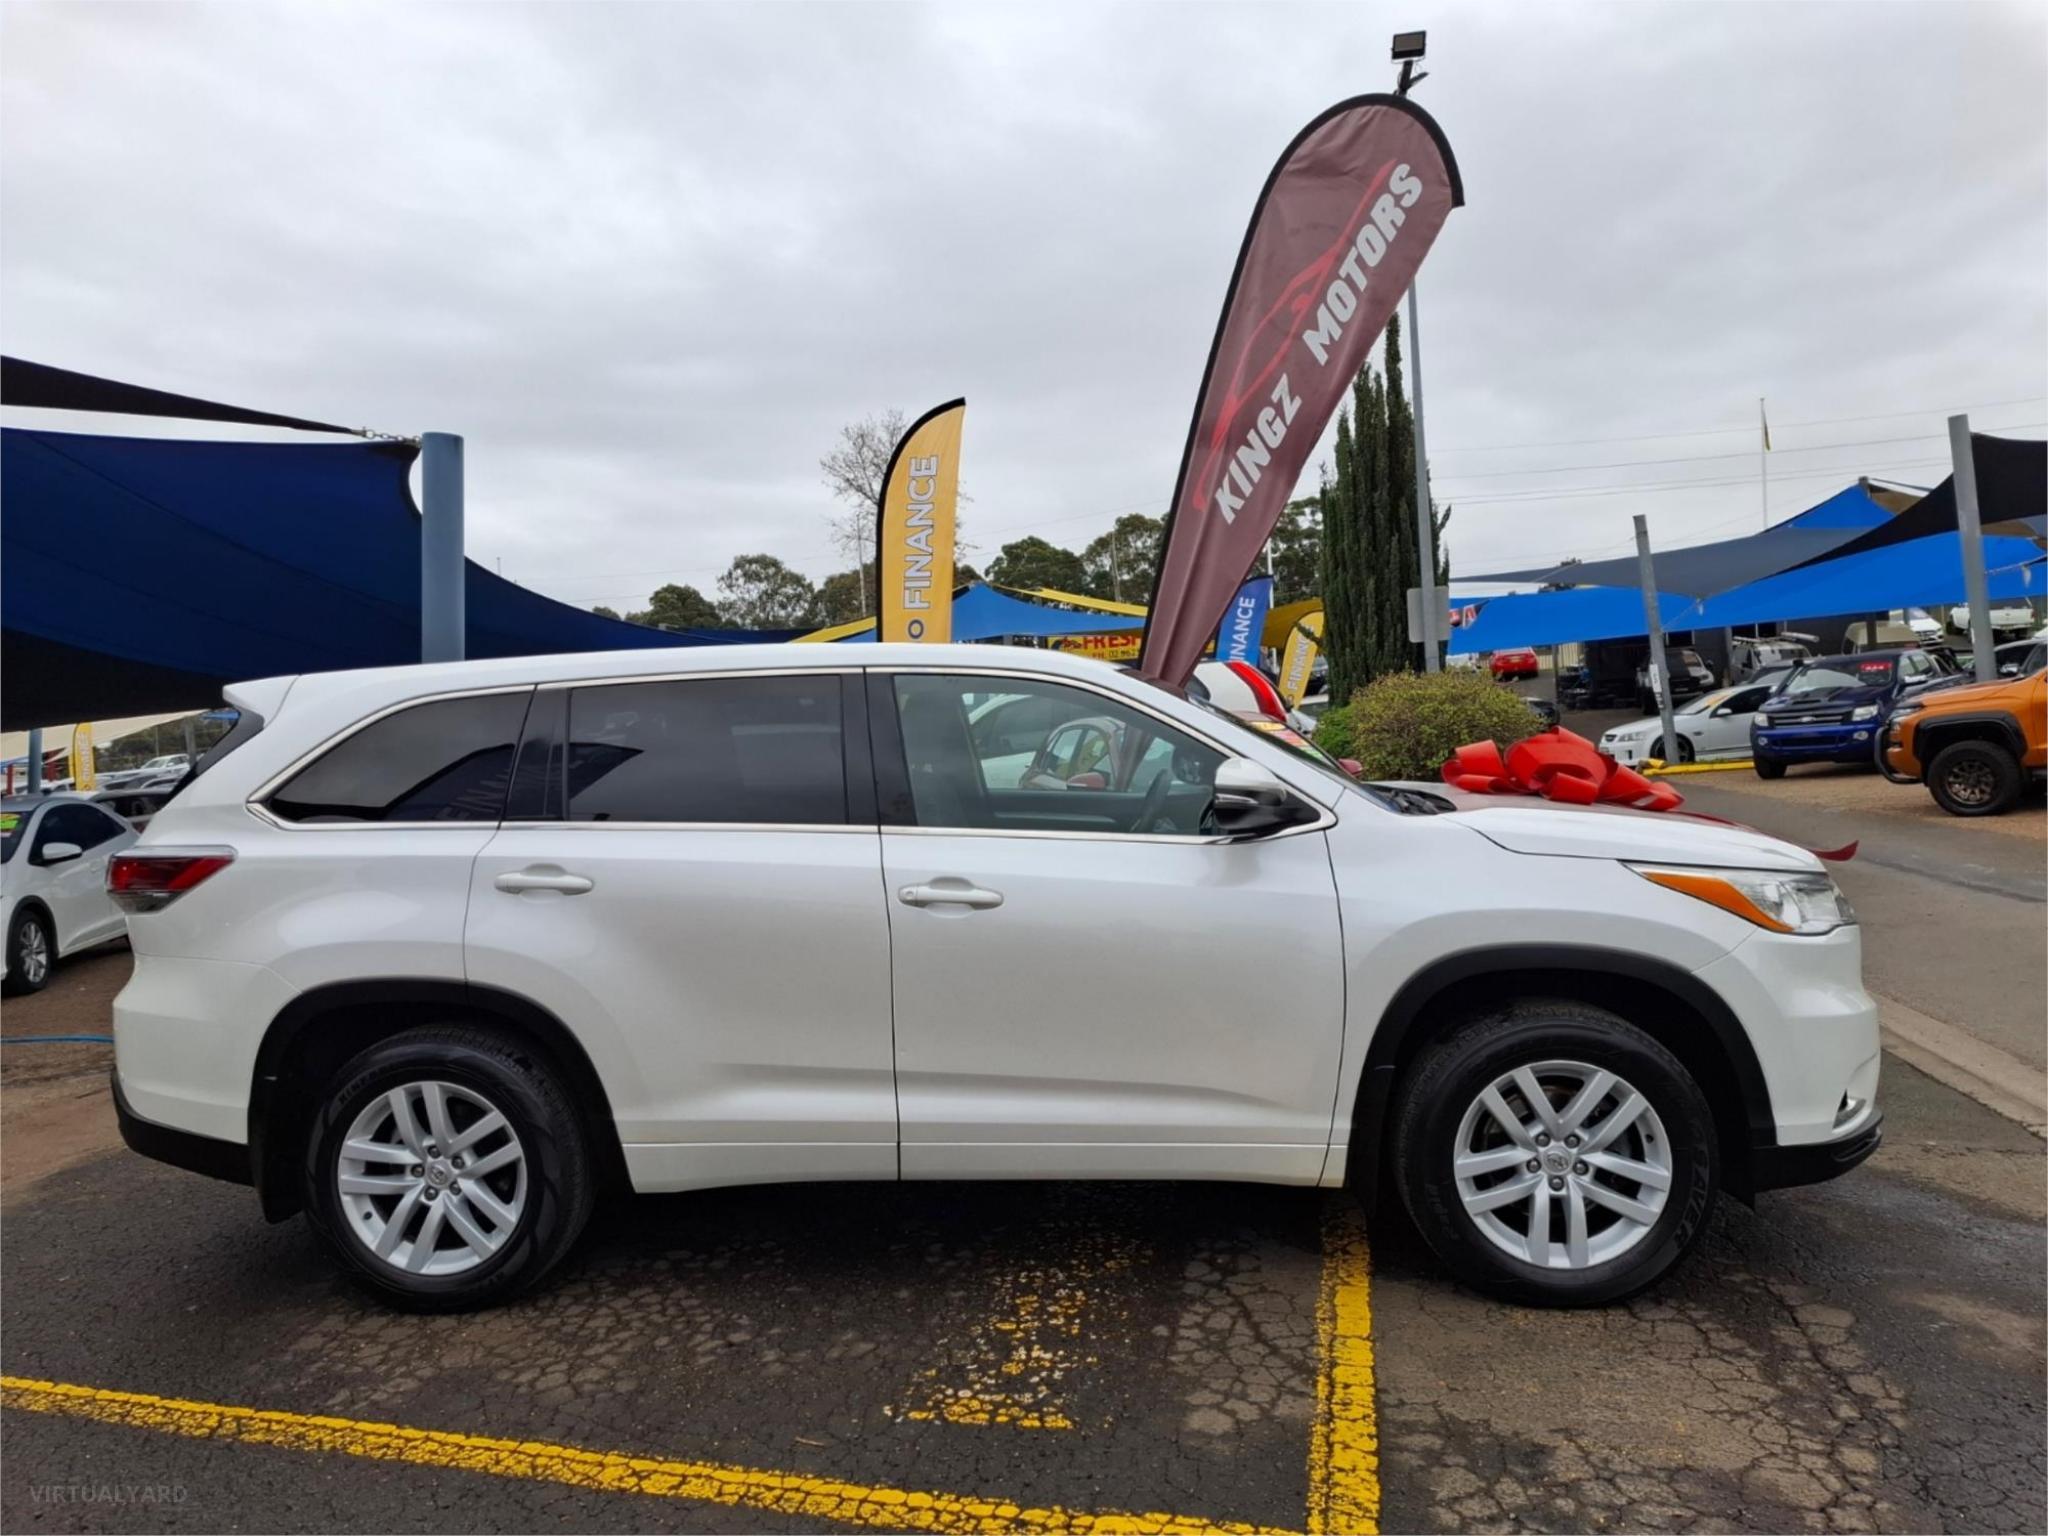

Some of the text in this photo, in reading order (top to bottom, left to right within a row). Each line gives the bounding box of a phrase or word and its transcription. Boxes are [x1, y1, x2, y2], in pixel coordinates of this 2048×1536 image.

[1215, 163, 1423, 525] KINGZ MOTORS
[903, 455, 938, 610] FINANCE
[1229, 596, 1256, 661] INANCE
